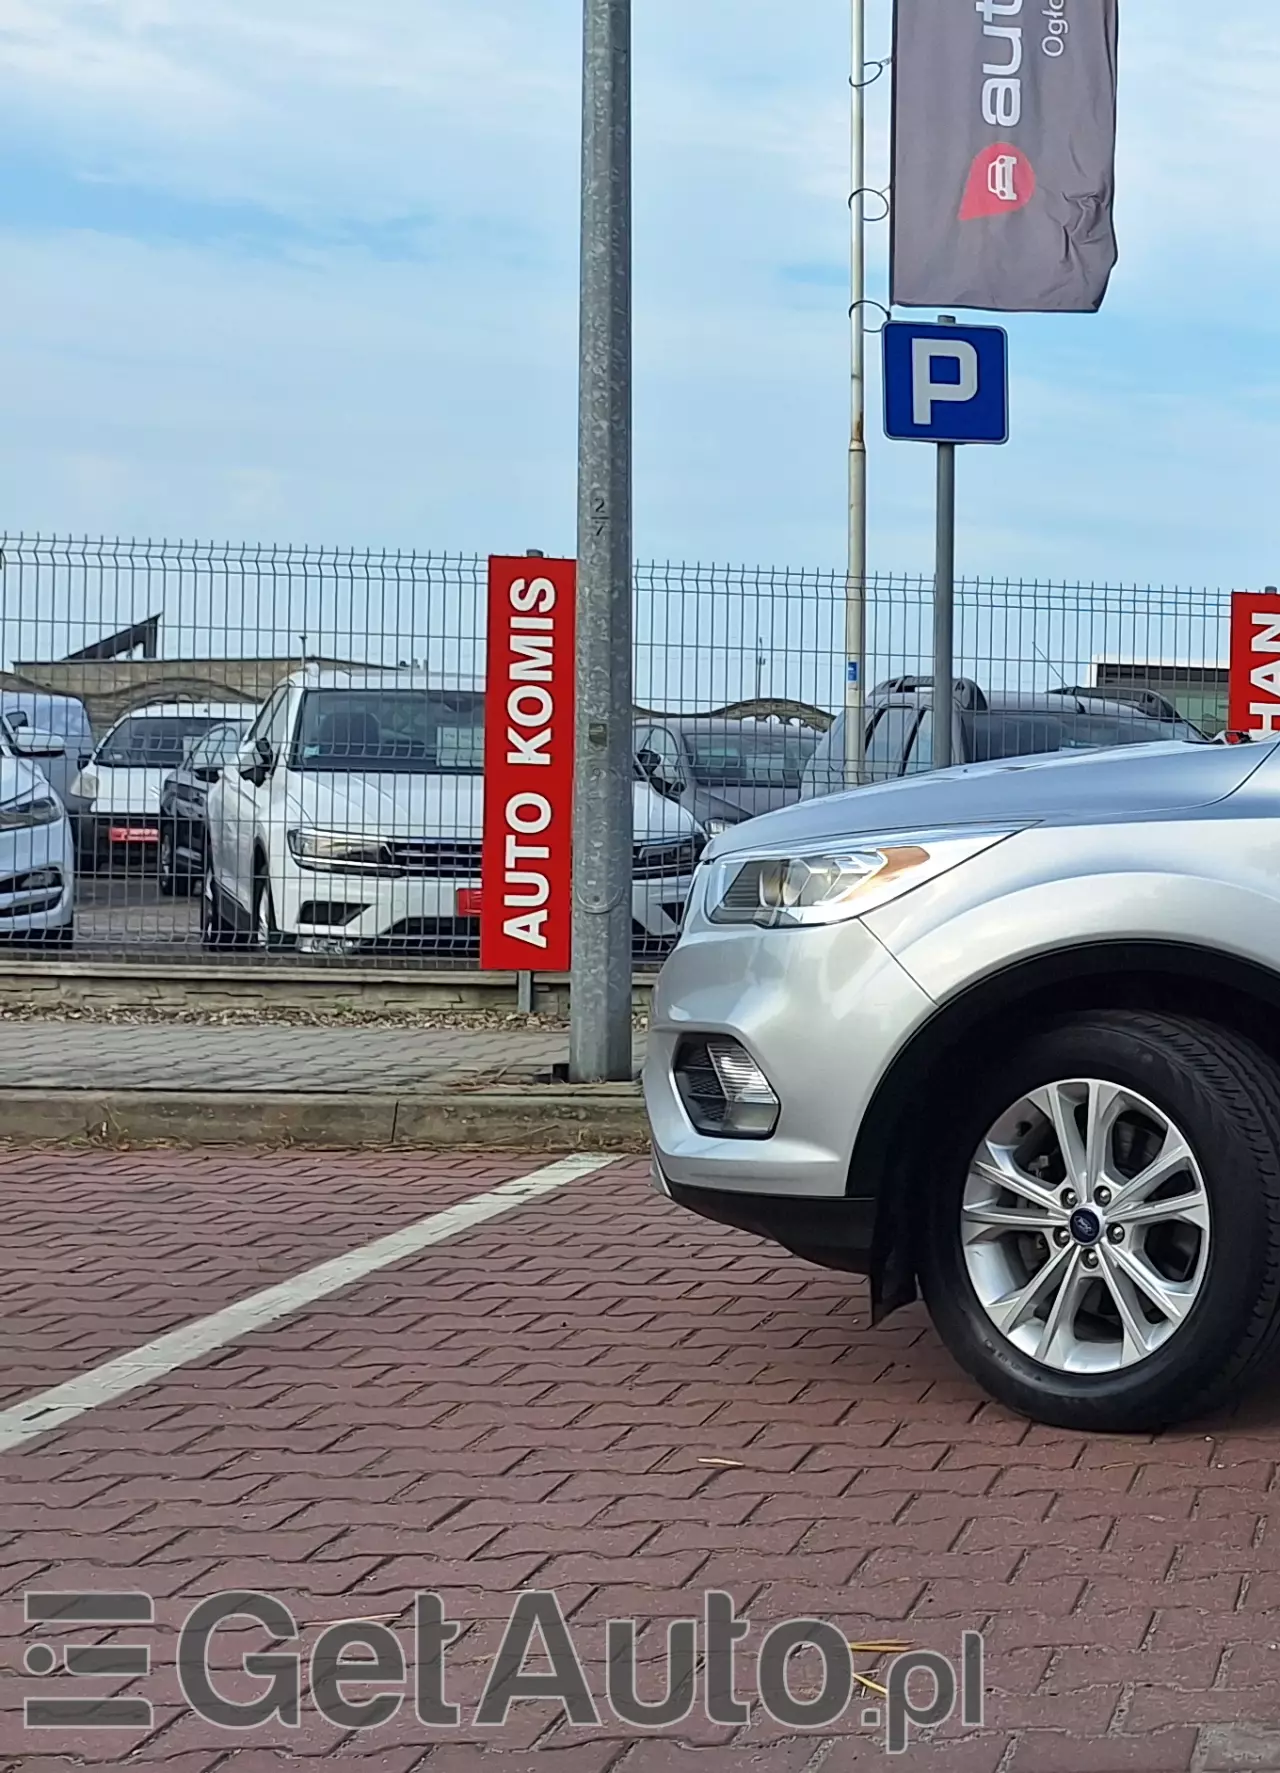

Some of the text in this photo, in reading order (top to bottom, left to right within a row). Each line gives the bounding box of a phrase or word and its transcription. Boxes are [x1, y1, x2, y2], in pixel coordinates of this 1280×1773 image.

[911, 337, 978, 425] P
[502, 576, 557, 949] AUTO KOMIS
